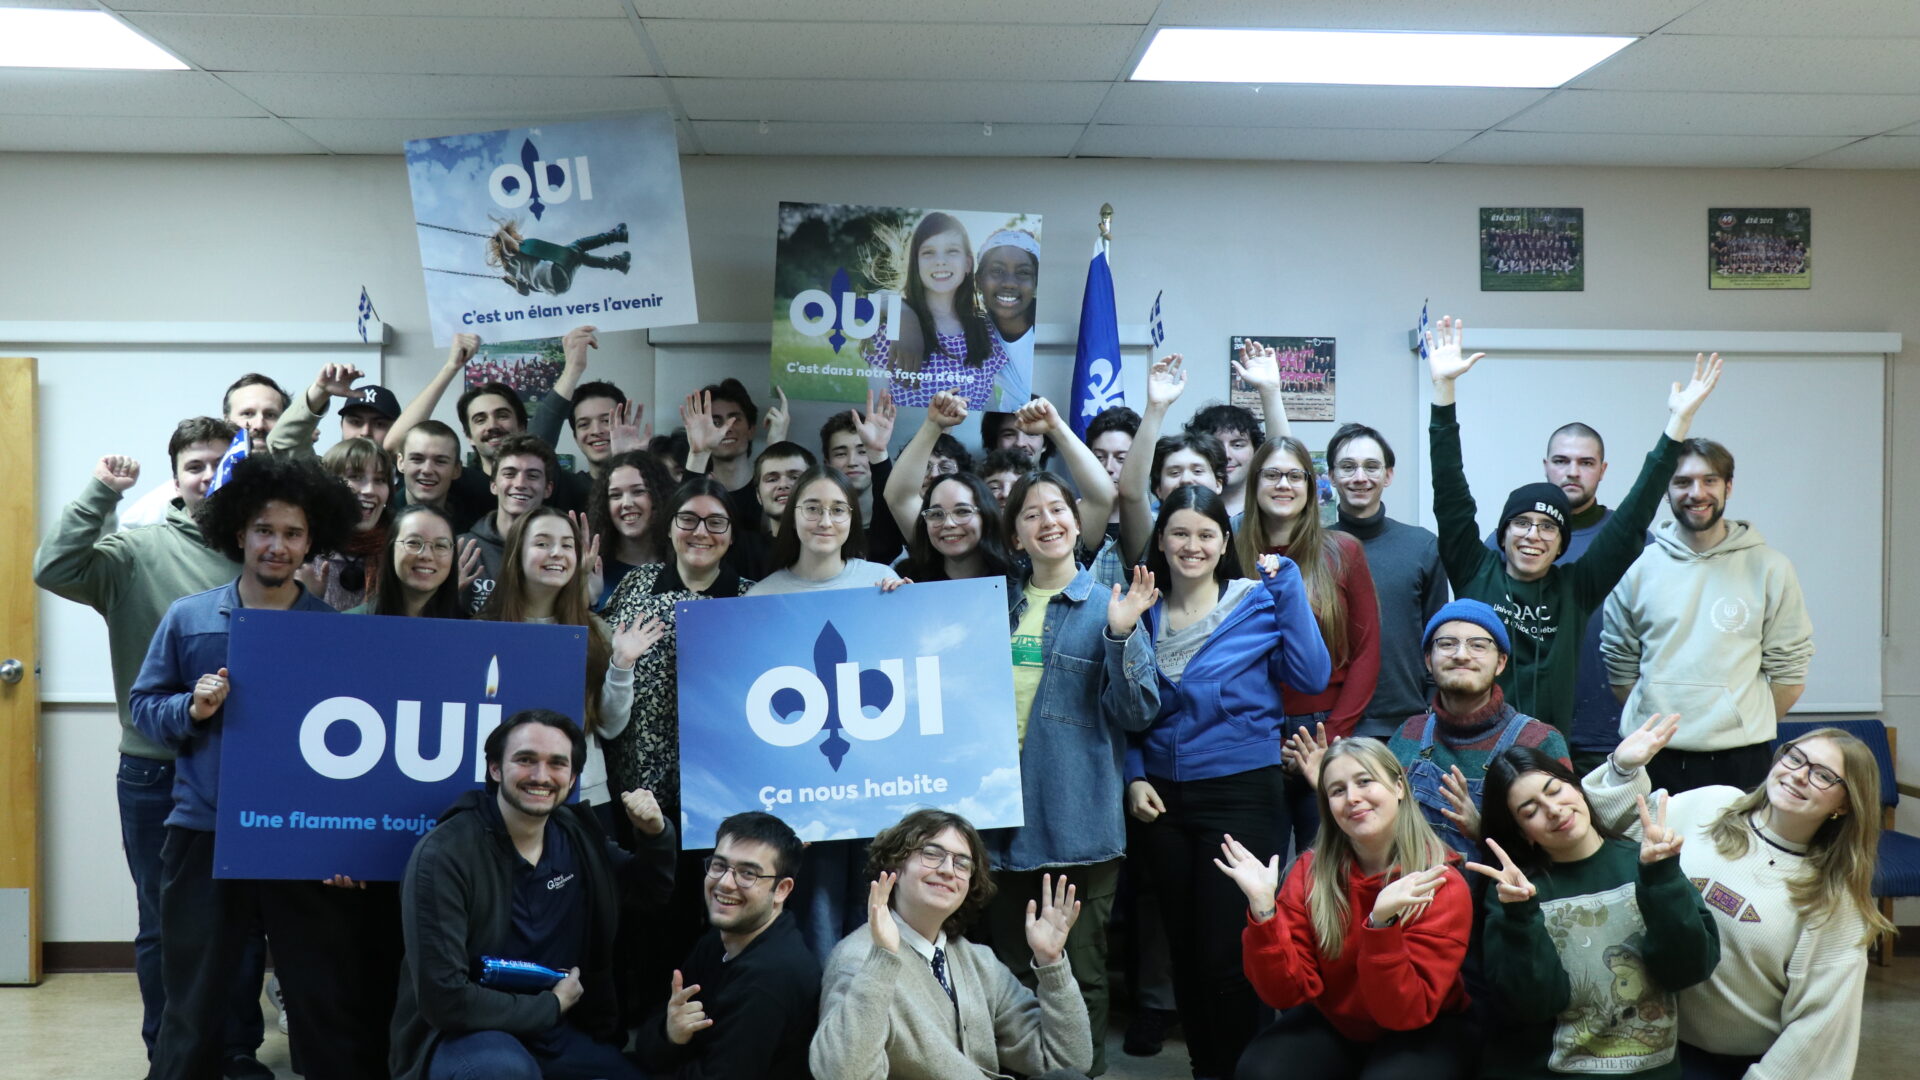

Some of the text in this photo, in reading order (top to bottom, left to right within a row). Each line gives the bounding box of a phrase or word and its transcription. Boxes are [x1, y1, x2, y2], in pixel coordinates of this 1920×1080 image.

[489, 156, 593, 208] OUI
[462, 293, 664, 325] C'est un élan vers l'avenir
[789, 289, 901, 341] OUI
[786, 361, 819, 374] C'est
[821, 366, 854, 377] dans
[856, 367, 893, 379] notre
[895, 368, 933, 385] façon
[746, 656, 944, 748] OUI
[758, 774, 948, 811] Ça nous habite
[240, 811, 283, 828] Une
[289, 811, 377, 830] flamme
[1592, 1059, 1617, 1069] THE
